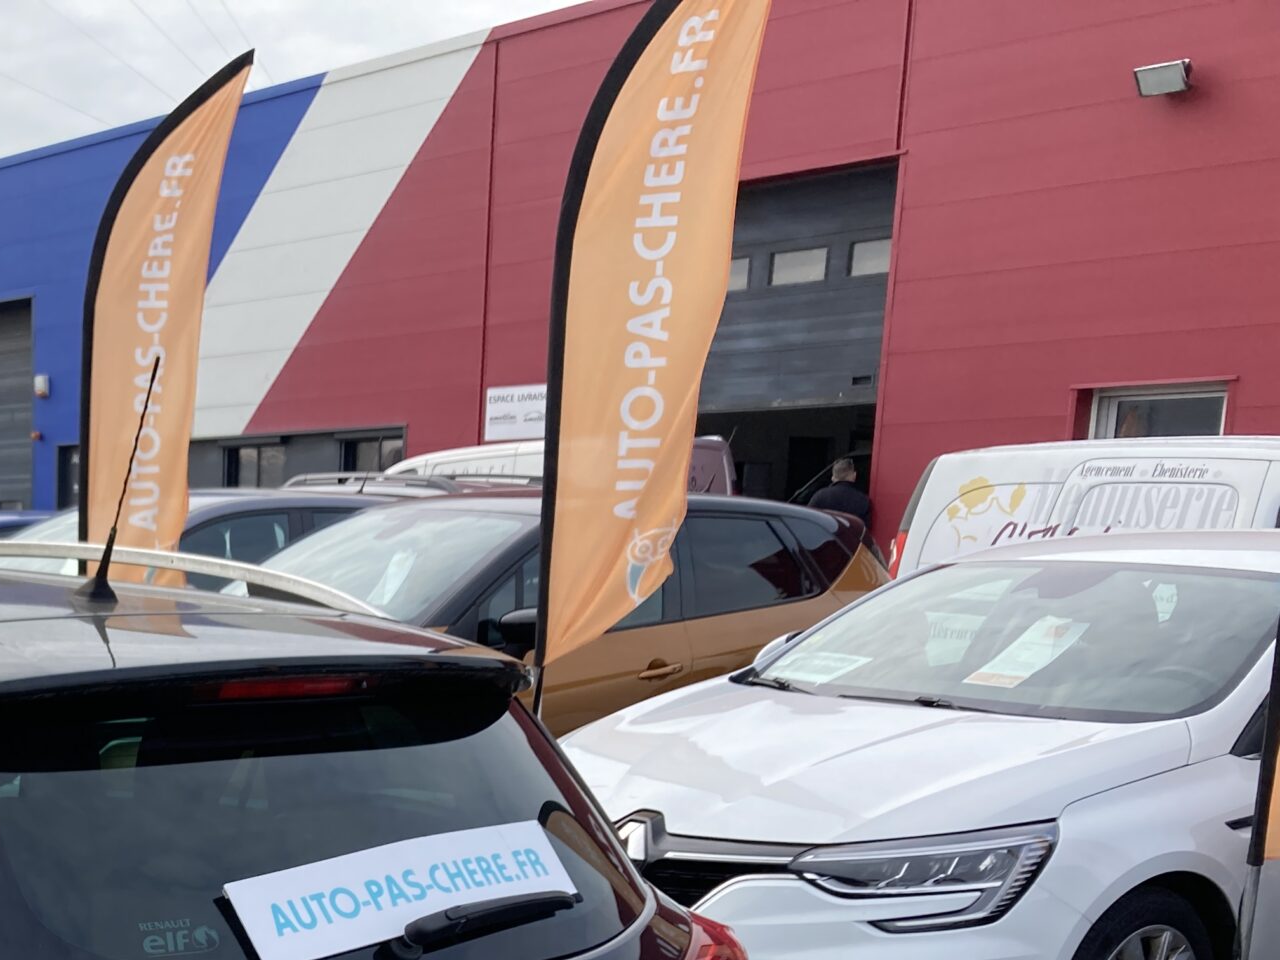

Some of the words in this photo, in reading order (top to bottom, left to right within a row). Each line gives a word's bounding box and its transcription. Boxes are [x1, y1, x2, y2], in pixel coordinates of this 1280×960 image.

[128, 152, 194, 532] AUTO-PAS-CHERE.FR
[489, 394, 515, 404] ESPACE
[1080, 463, 1137, 481] Agencement
[270, 847, 550, 938] AUTO-PAS-CHERE.FR
[138, 919, 191, 931] RENAULT
[143, 930, 190, 954] elf
